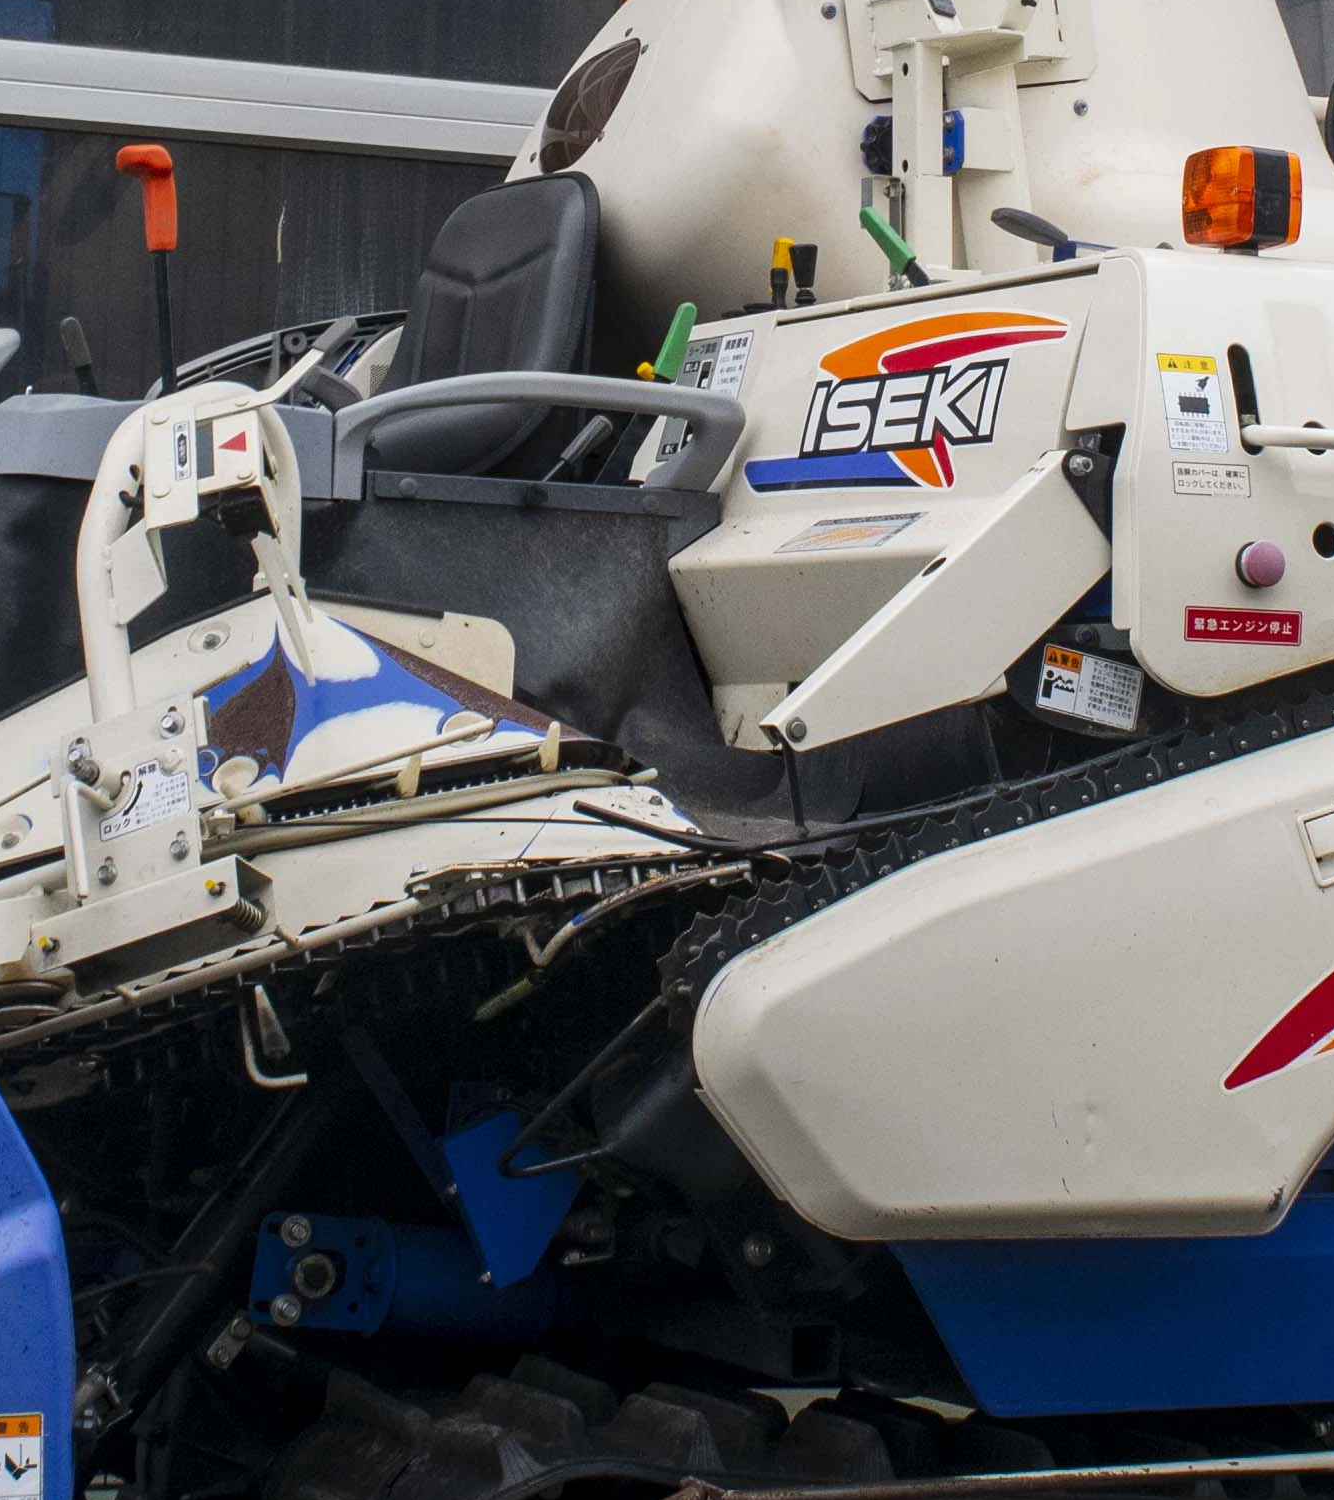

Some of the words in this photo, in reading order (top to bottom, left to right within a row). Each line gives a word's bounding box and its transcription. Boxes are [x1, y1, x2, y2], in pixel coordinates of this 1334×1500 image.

[798, 358, 1010, 458] ISEKI
[1178, 479, 1244, 490] ロックしてください。
[1193, 617, 1293, 636] 緊急エンジン停止
[103, 818, 130, 835] ロック
